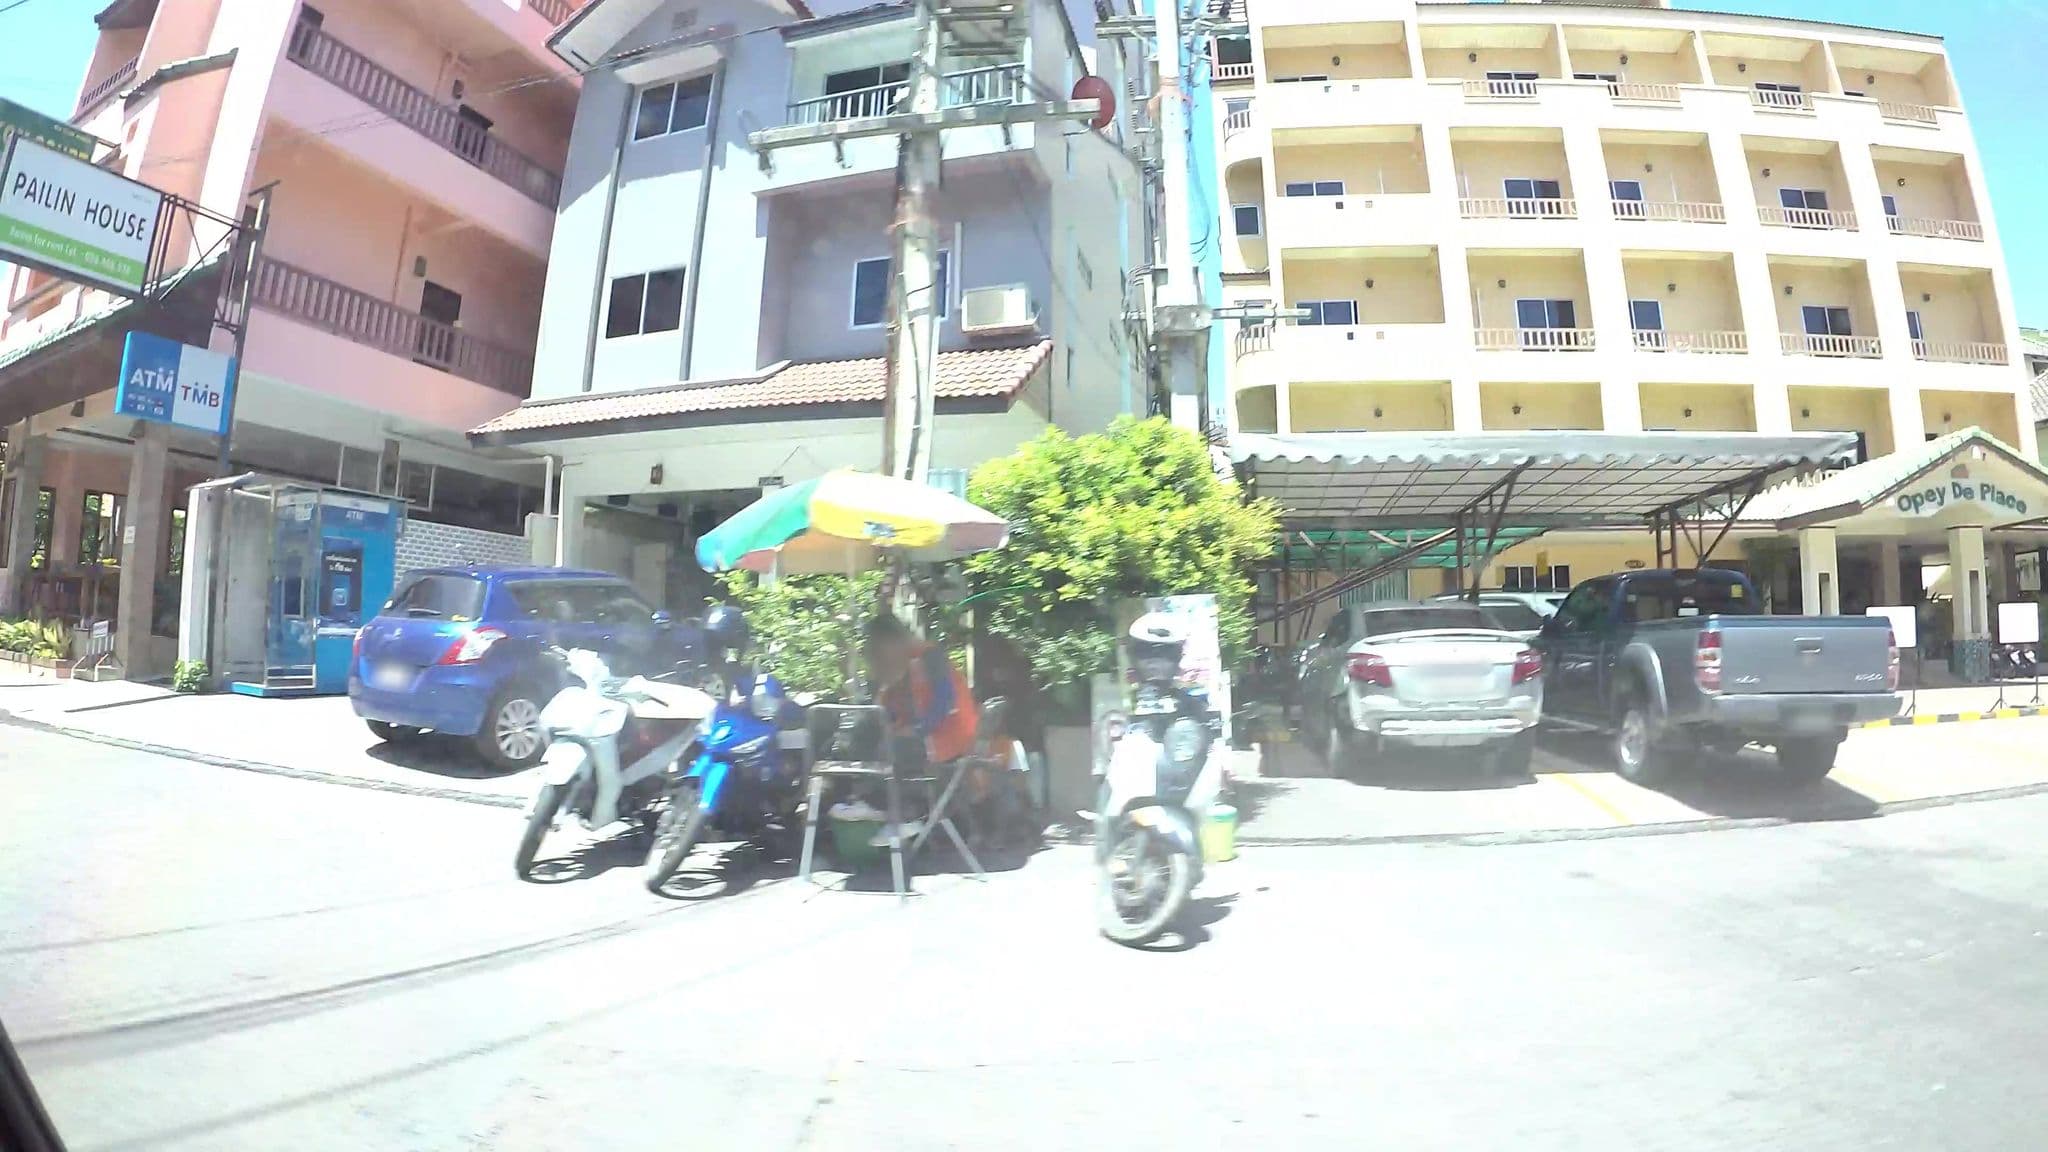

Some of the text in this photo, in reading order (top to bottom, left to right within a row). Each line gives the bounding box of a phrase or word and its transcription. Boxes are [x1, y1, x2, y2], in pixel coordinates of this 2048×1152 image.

[13, 172, 147, 241] PAILIN HOUSE
[130, 367, 175, 393] ATM
[181, 381, 220, 408] TMB
[1897, 481, 2027, 514] Opey De Place
[346, 510, 363, 522] ATM
